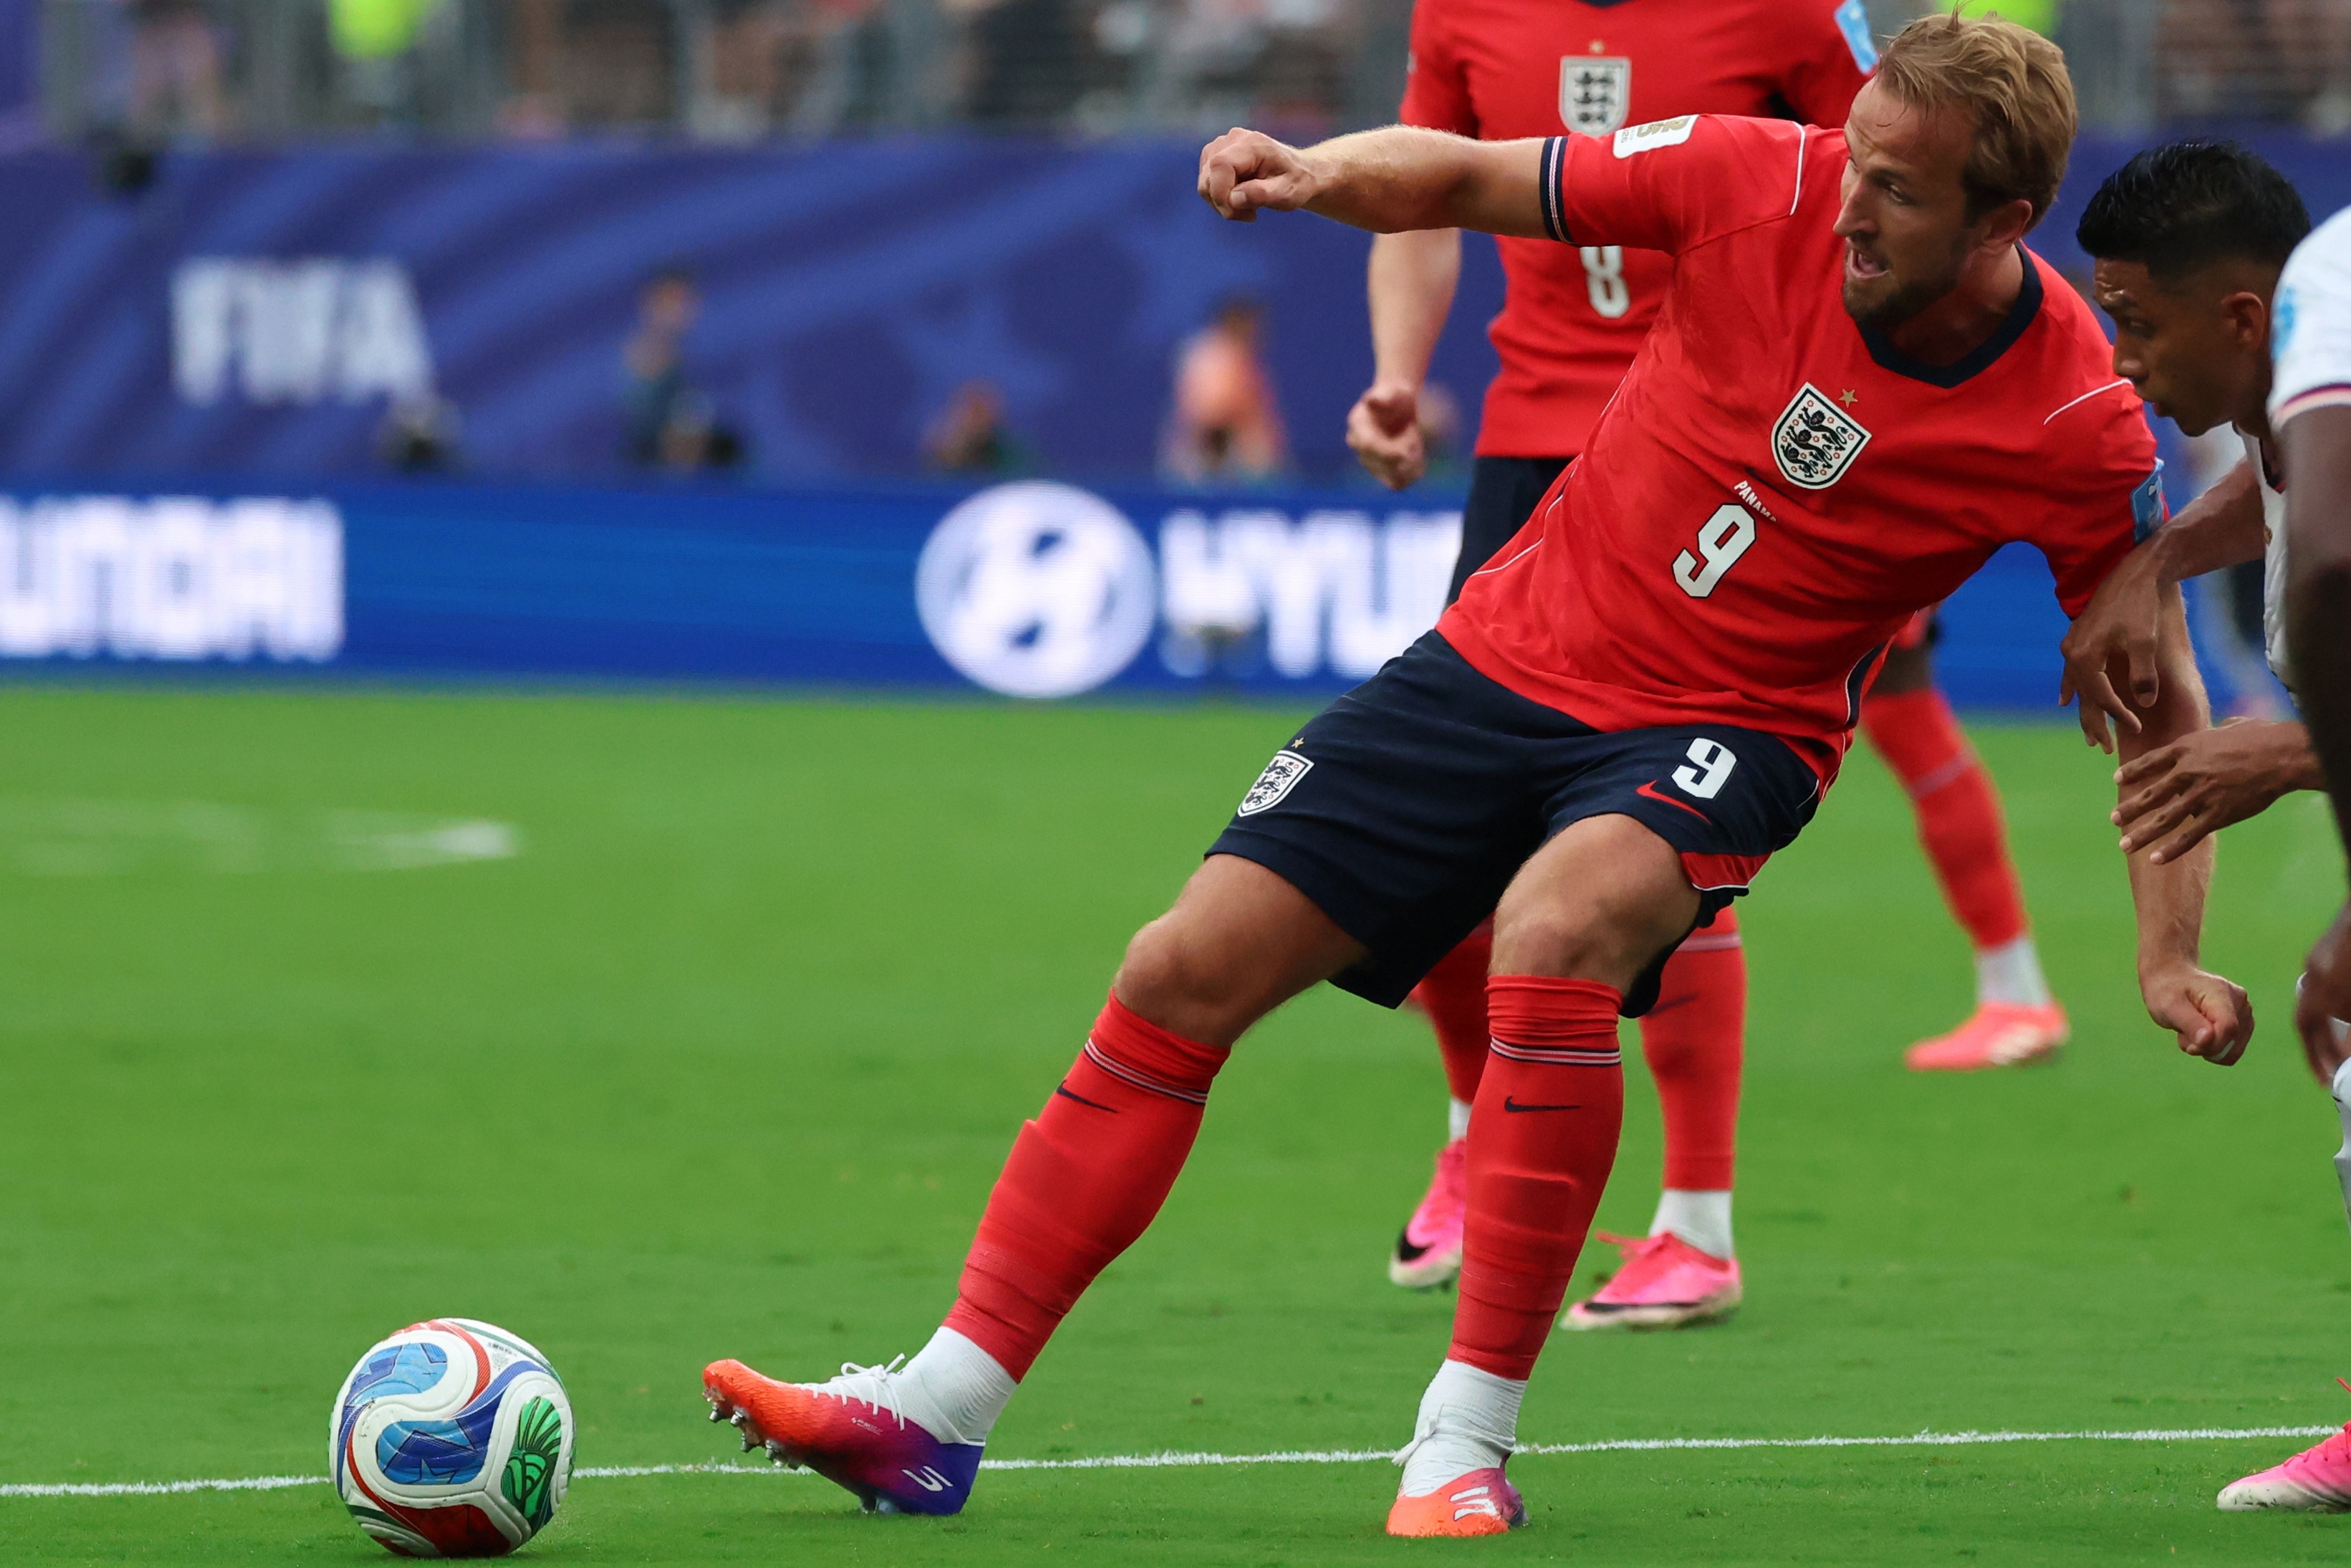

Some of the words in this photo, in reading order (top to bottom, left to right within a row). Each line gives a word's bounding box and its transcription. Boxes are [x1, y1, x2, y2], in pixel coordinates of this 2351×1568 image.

[1579, 246, 1630, 319] 8
[171, 256, 431, 406] FIFA
[1672, 503, 1756, 597] 9
[1671, 737, 1737, 799] 9
